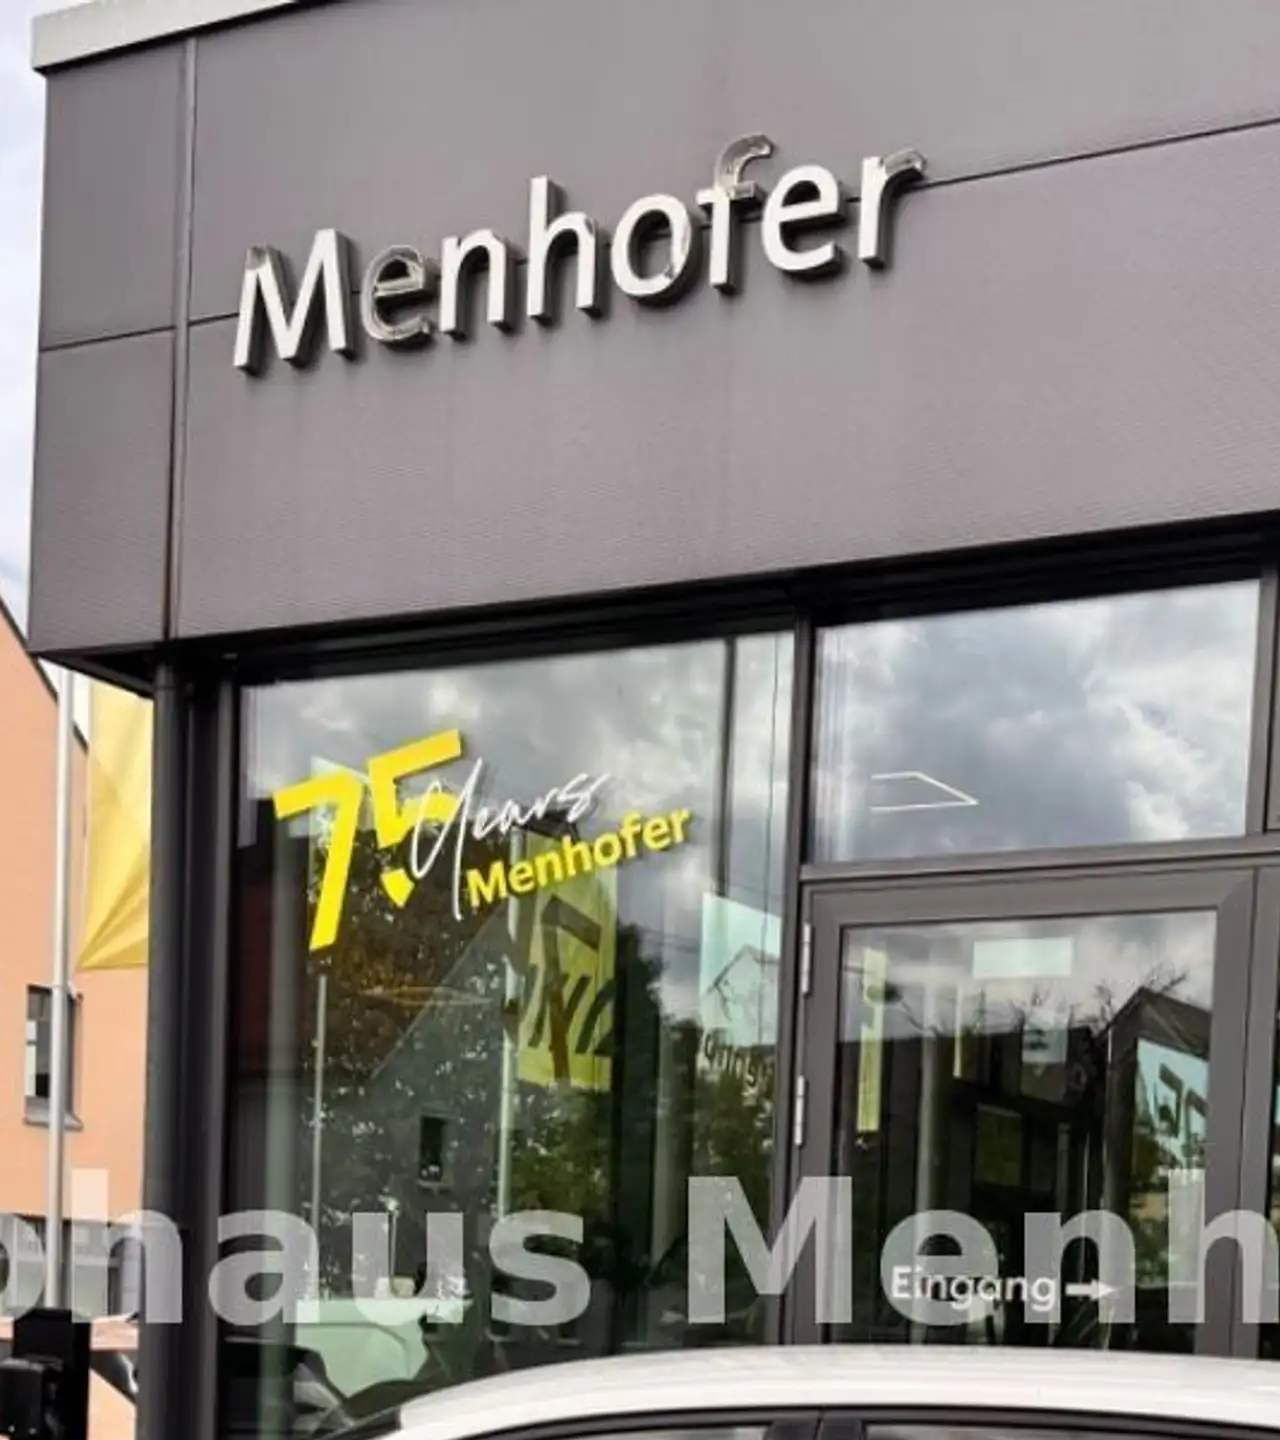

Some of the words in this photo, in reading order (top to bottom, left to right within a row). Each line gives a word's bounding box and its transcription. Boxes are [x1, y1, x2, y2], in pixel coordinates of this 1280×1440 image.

[233, 132, 928, 374] Menhofer
[273, 729, 462, 951] 75
[411, 757, 613, 922] Years
[466, 806, 693, 908] Menhofer
[889, 1265, 1057, 1312] Eingang
